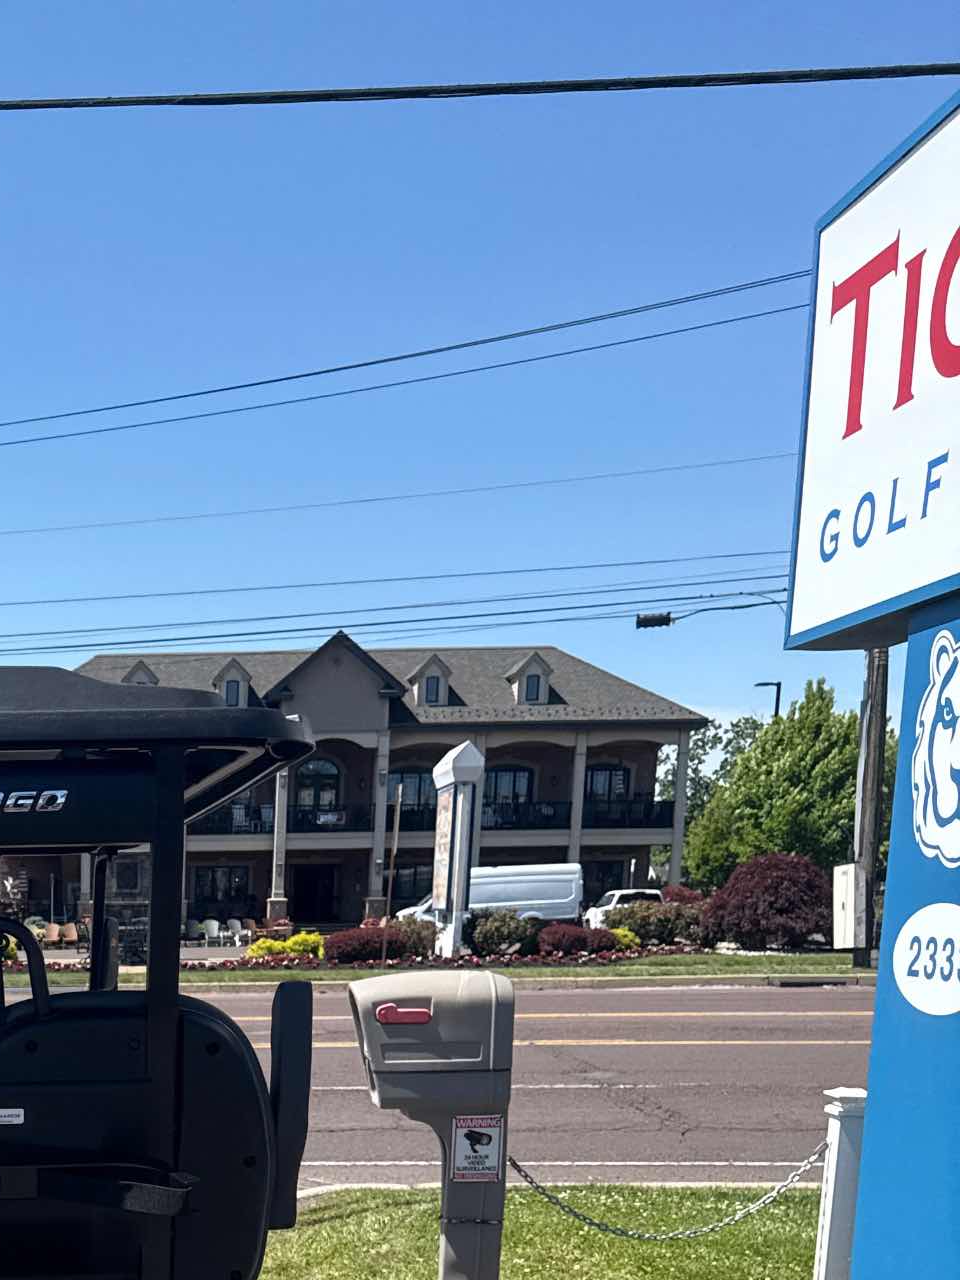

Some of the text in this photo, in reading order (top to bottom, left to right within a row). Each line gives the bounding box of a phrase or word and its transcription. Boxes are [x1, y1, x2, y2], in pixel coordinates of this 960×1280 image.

[819, 449, 950, 563] GOLF
[906, 935, 960, 984] 233
[456, 1117, 501, 1129] WARNING
